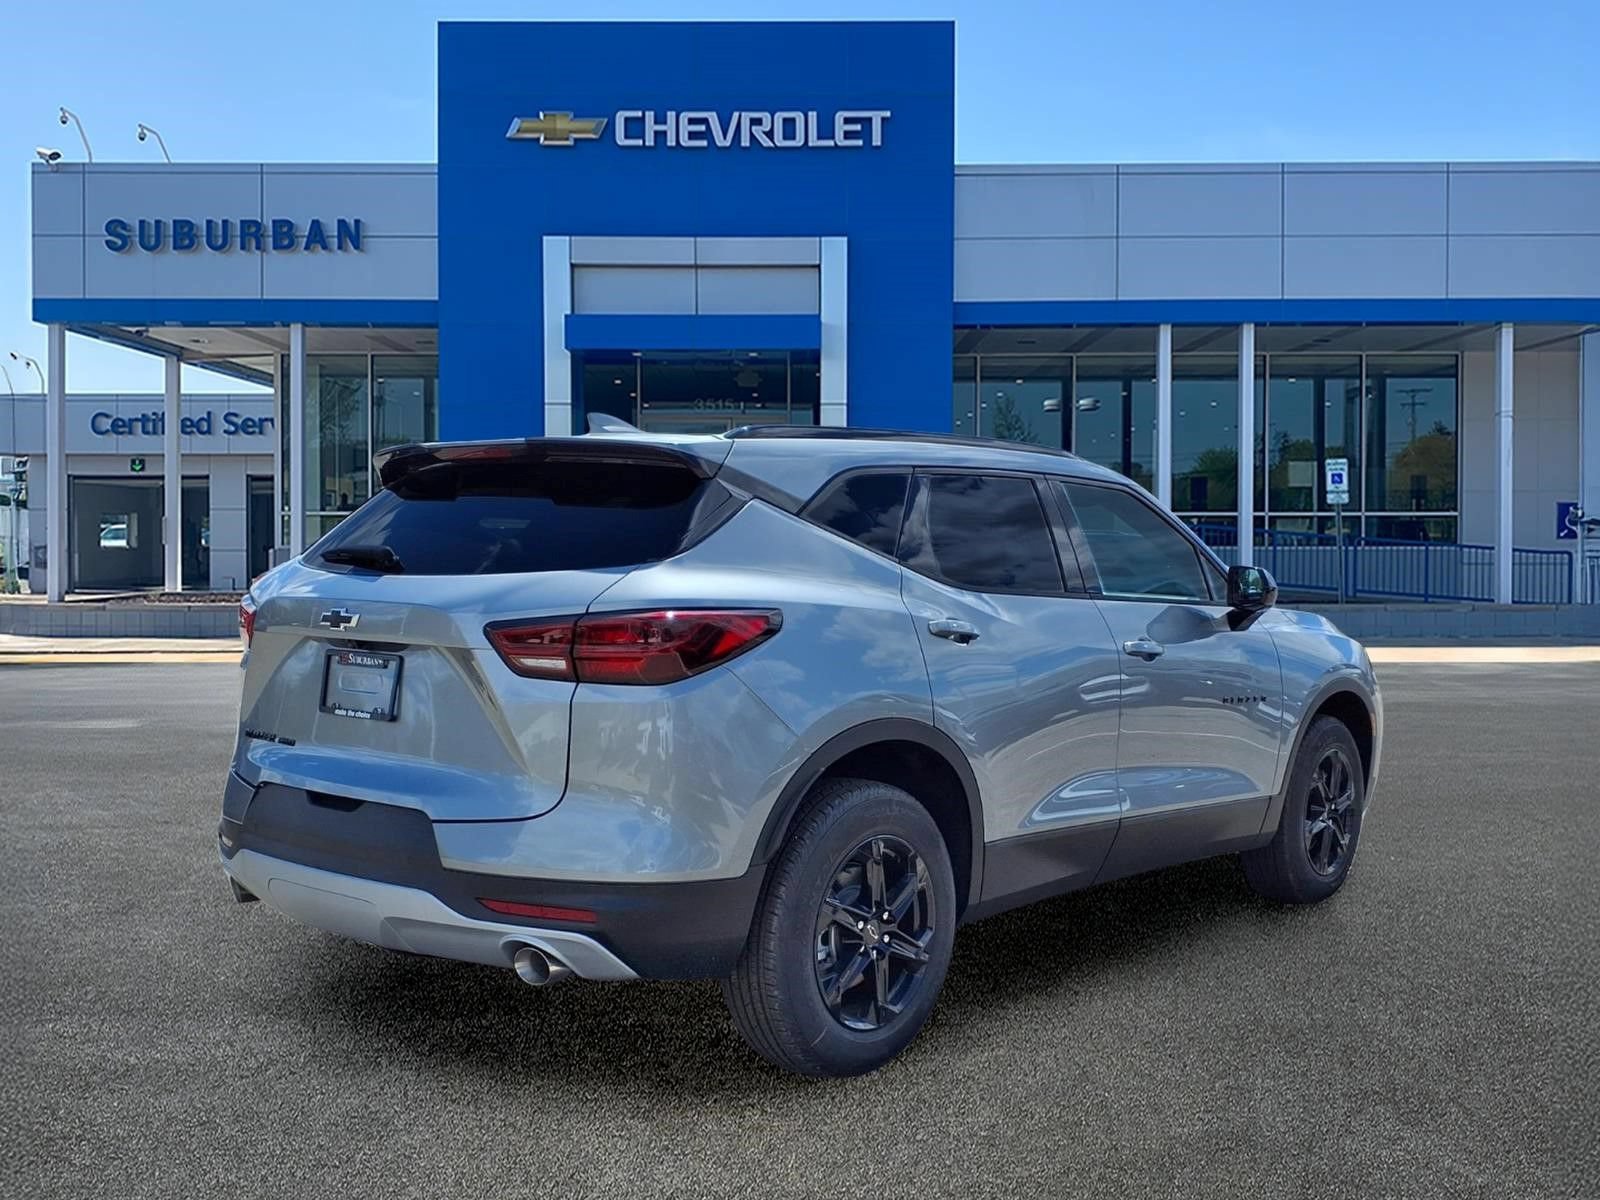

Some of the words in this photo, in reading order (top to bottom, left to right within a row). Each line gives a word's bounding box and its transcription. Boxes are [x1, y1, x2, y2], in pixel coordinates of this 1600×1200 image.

[615, 111, 892, 148] CHEVROLET
[104, 218, 363, 252] SUBURBAN
[90, 411, 212, 436] Certifed
